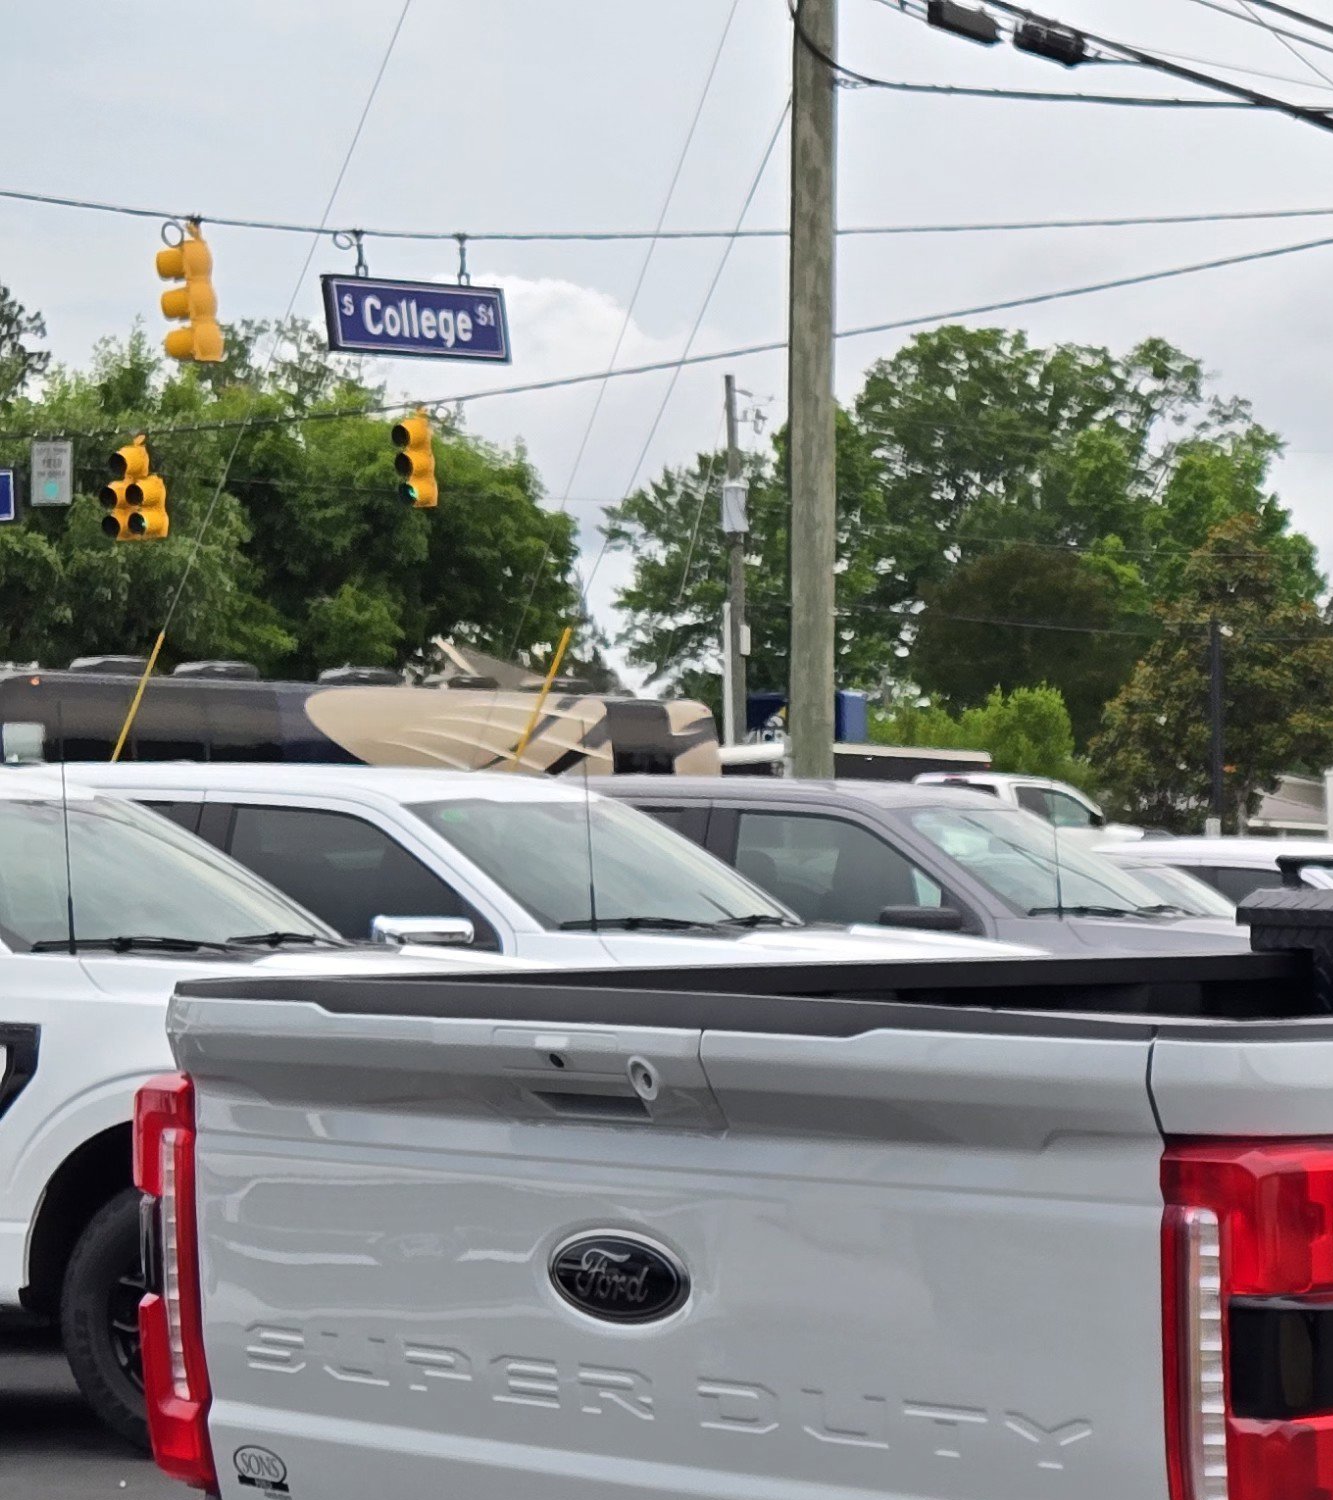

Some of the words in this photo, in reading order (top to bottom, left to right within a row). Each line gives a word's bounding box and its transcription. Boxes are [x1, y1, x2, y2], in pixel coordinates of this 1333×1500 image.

[341, 293, 355, 316] S
[362, 295, 473, 348] College
[475, 302, 495, 327] St
[575, 1248, 650, 1303] Ford
[246, 1322, 655, 1421] SUPER
[697, 1376, 1094, 1470] DUTY
[239, 1452, 281, 1479] SONS
